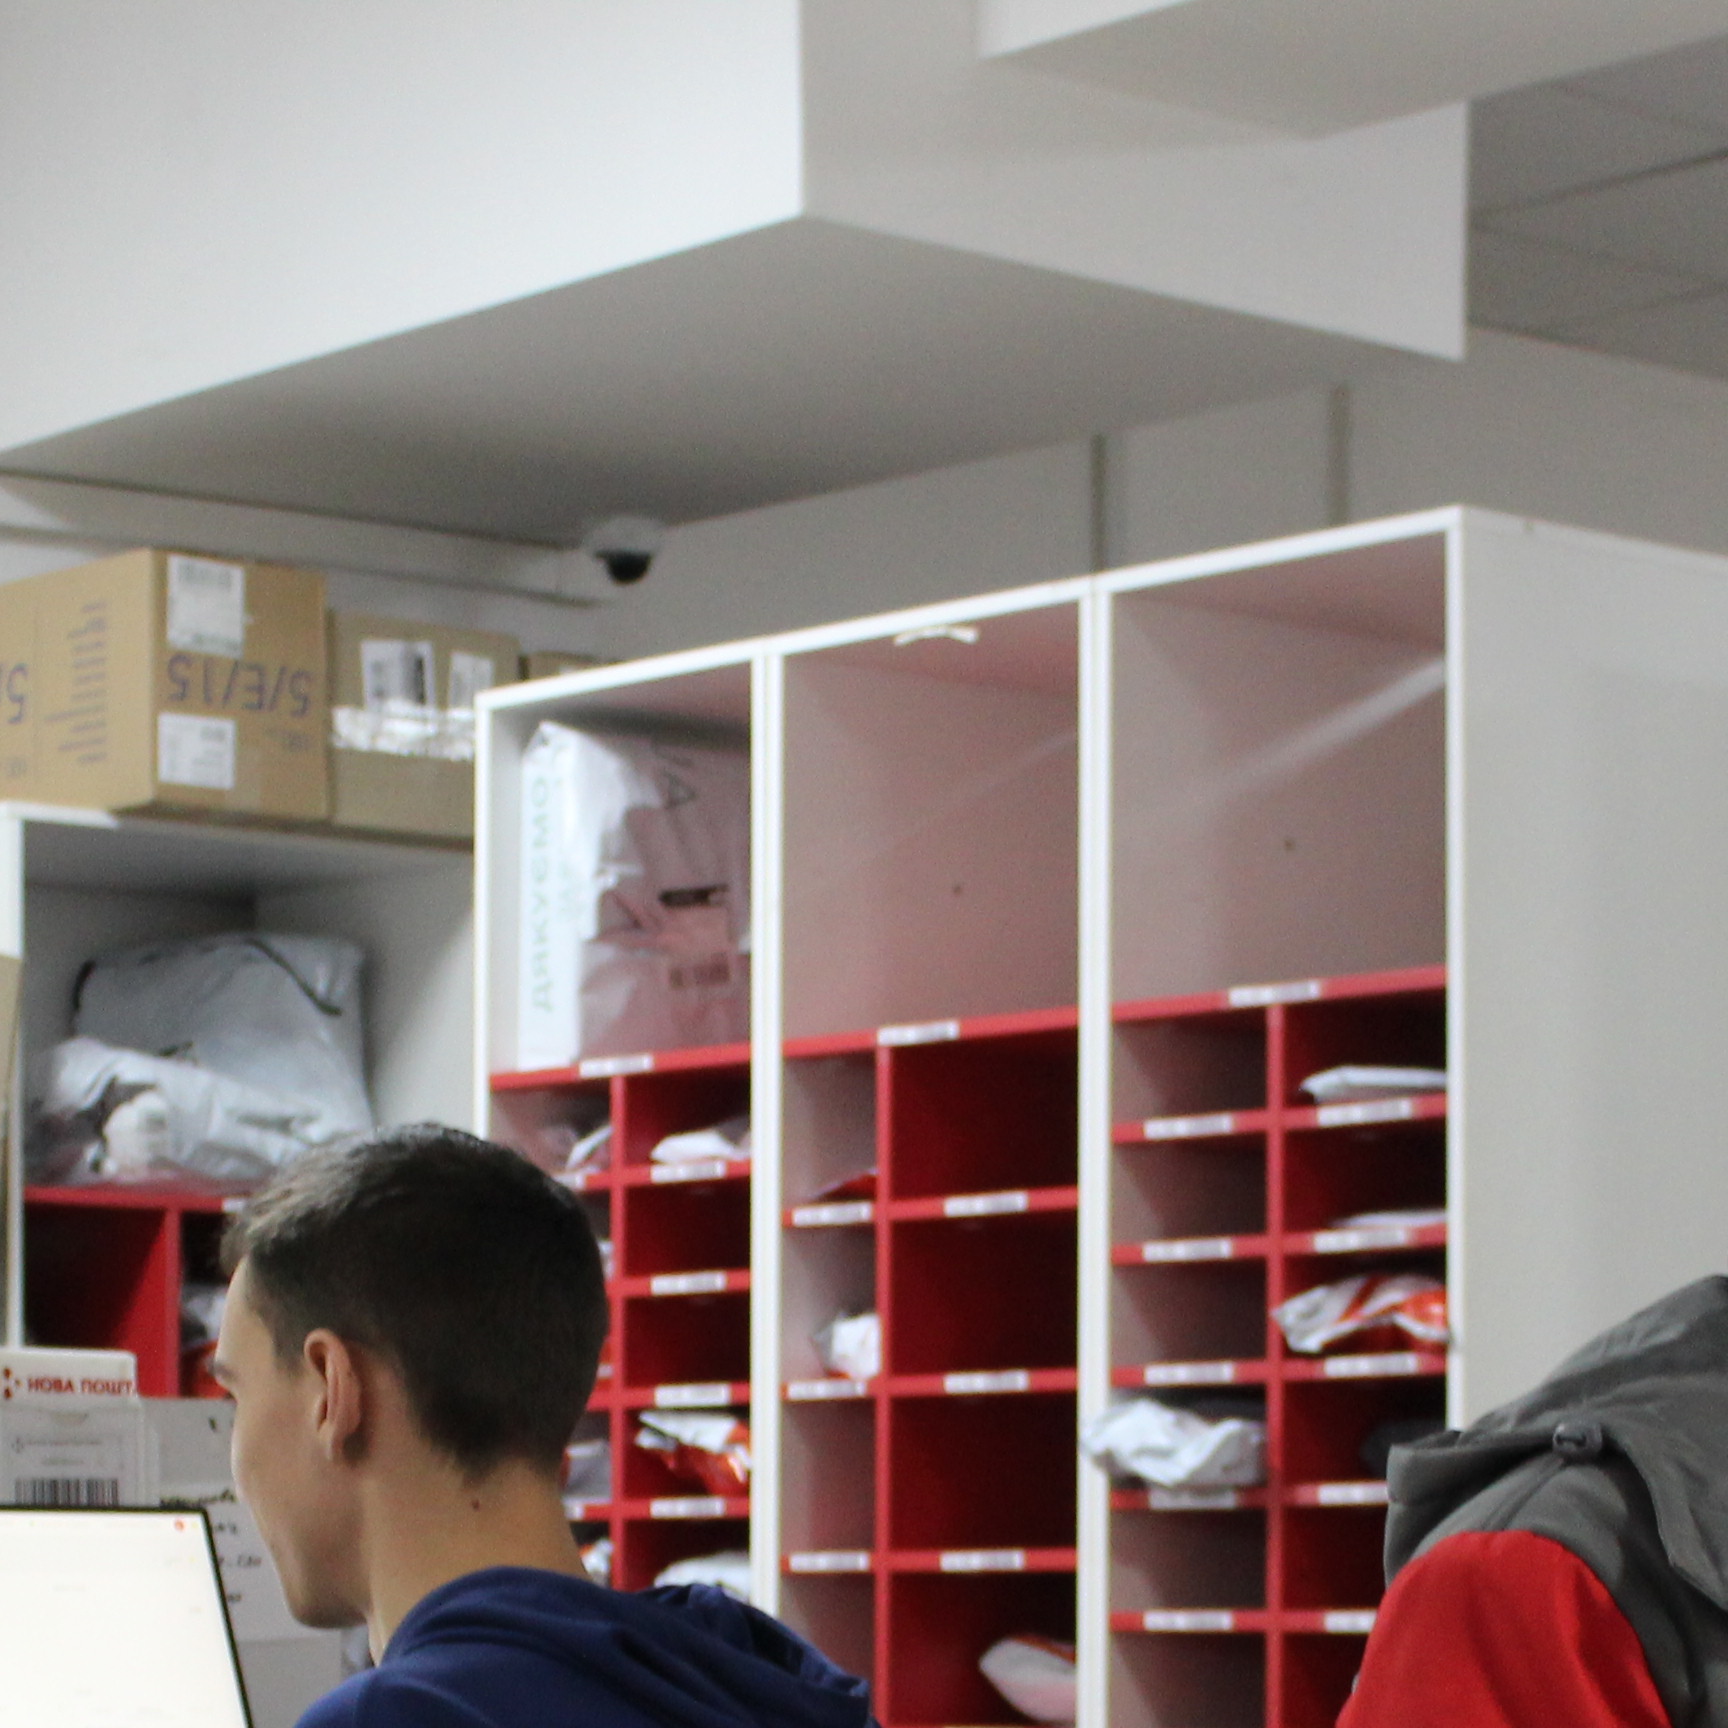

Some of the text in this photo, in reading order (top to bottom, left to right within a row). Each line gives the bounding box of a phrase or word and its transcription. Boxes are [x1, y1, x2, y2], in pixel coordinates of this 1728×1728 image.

[530, 777, 555, 1013] ДЯКУЄМО
[27, 1377, 137, 1395] НОВА ПОШТ
